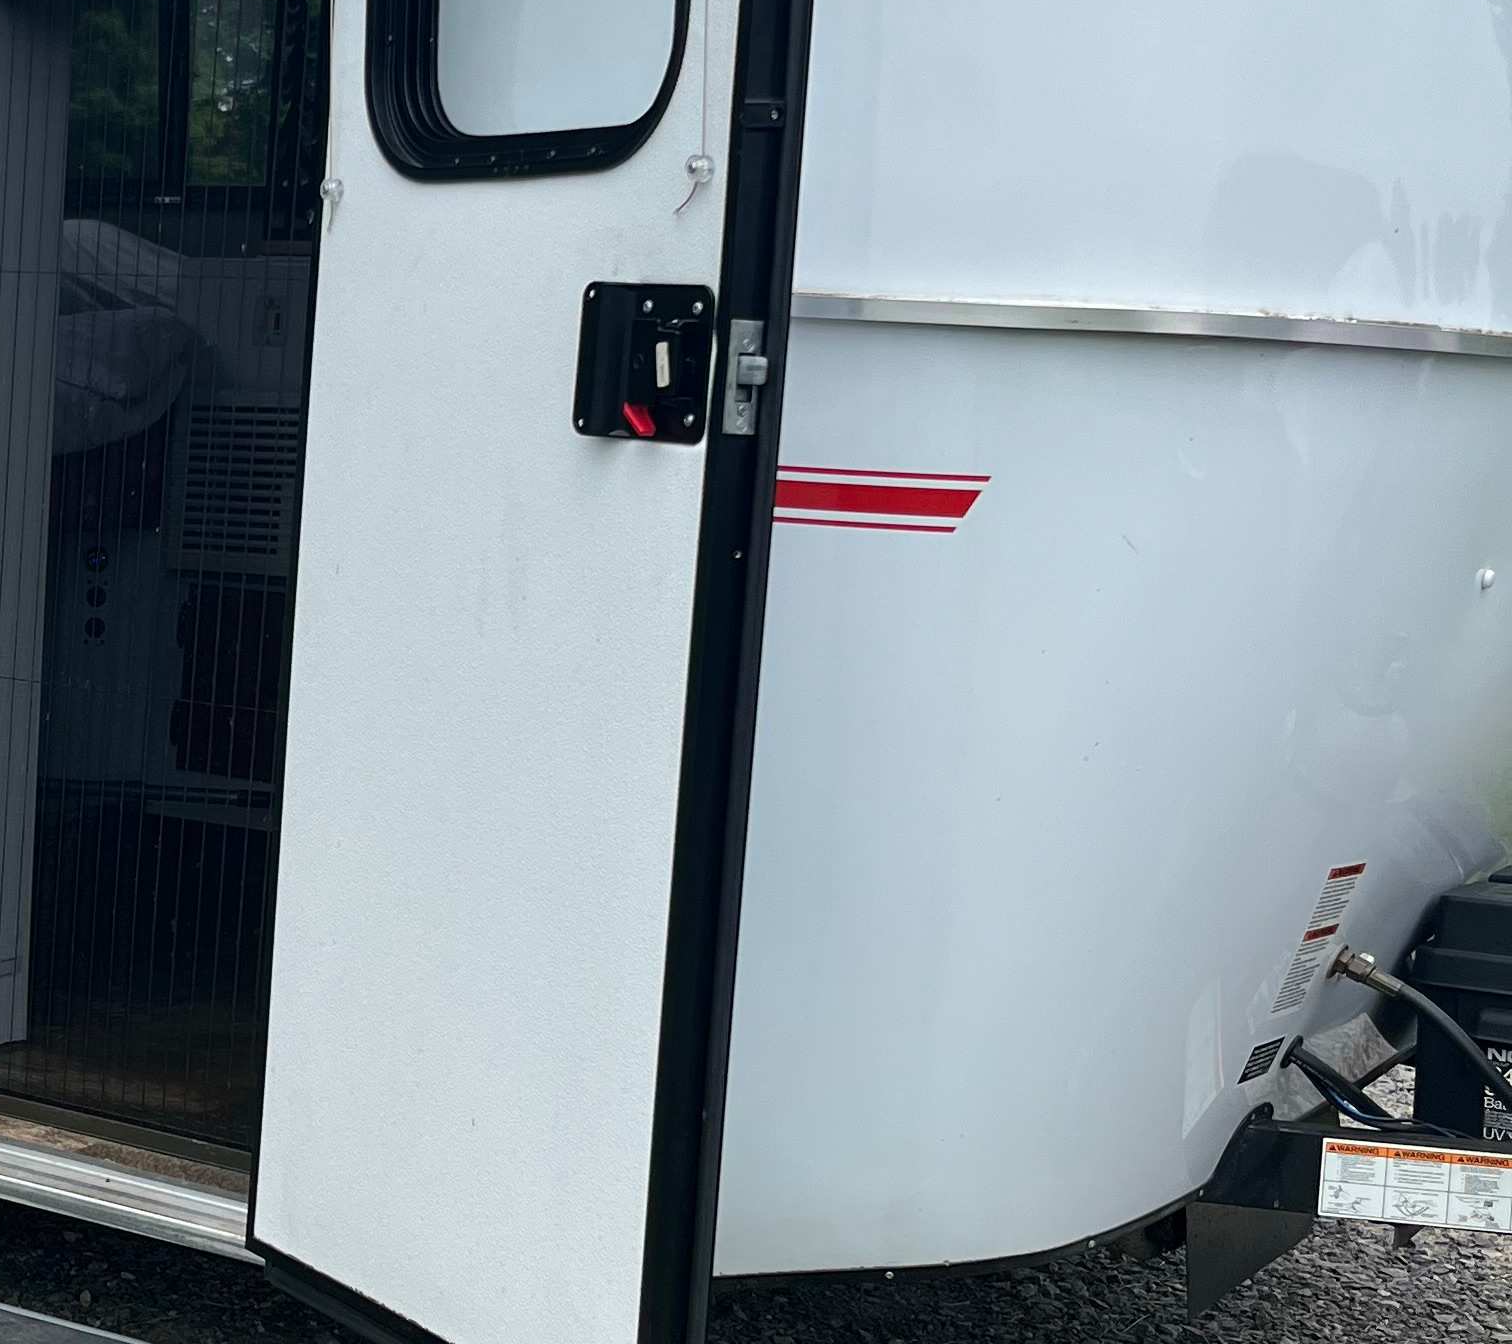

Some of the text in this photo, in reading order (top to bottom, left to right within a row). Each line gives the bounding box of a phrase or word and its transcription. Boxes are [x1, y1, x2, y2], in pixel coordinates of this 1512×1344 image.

[1337, 1144, 1380, 1155] WARNING
[1401, 1151, 1446, 1161] WARNING
[1465, 1156, 1510, 1167] WARNING
